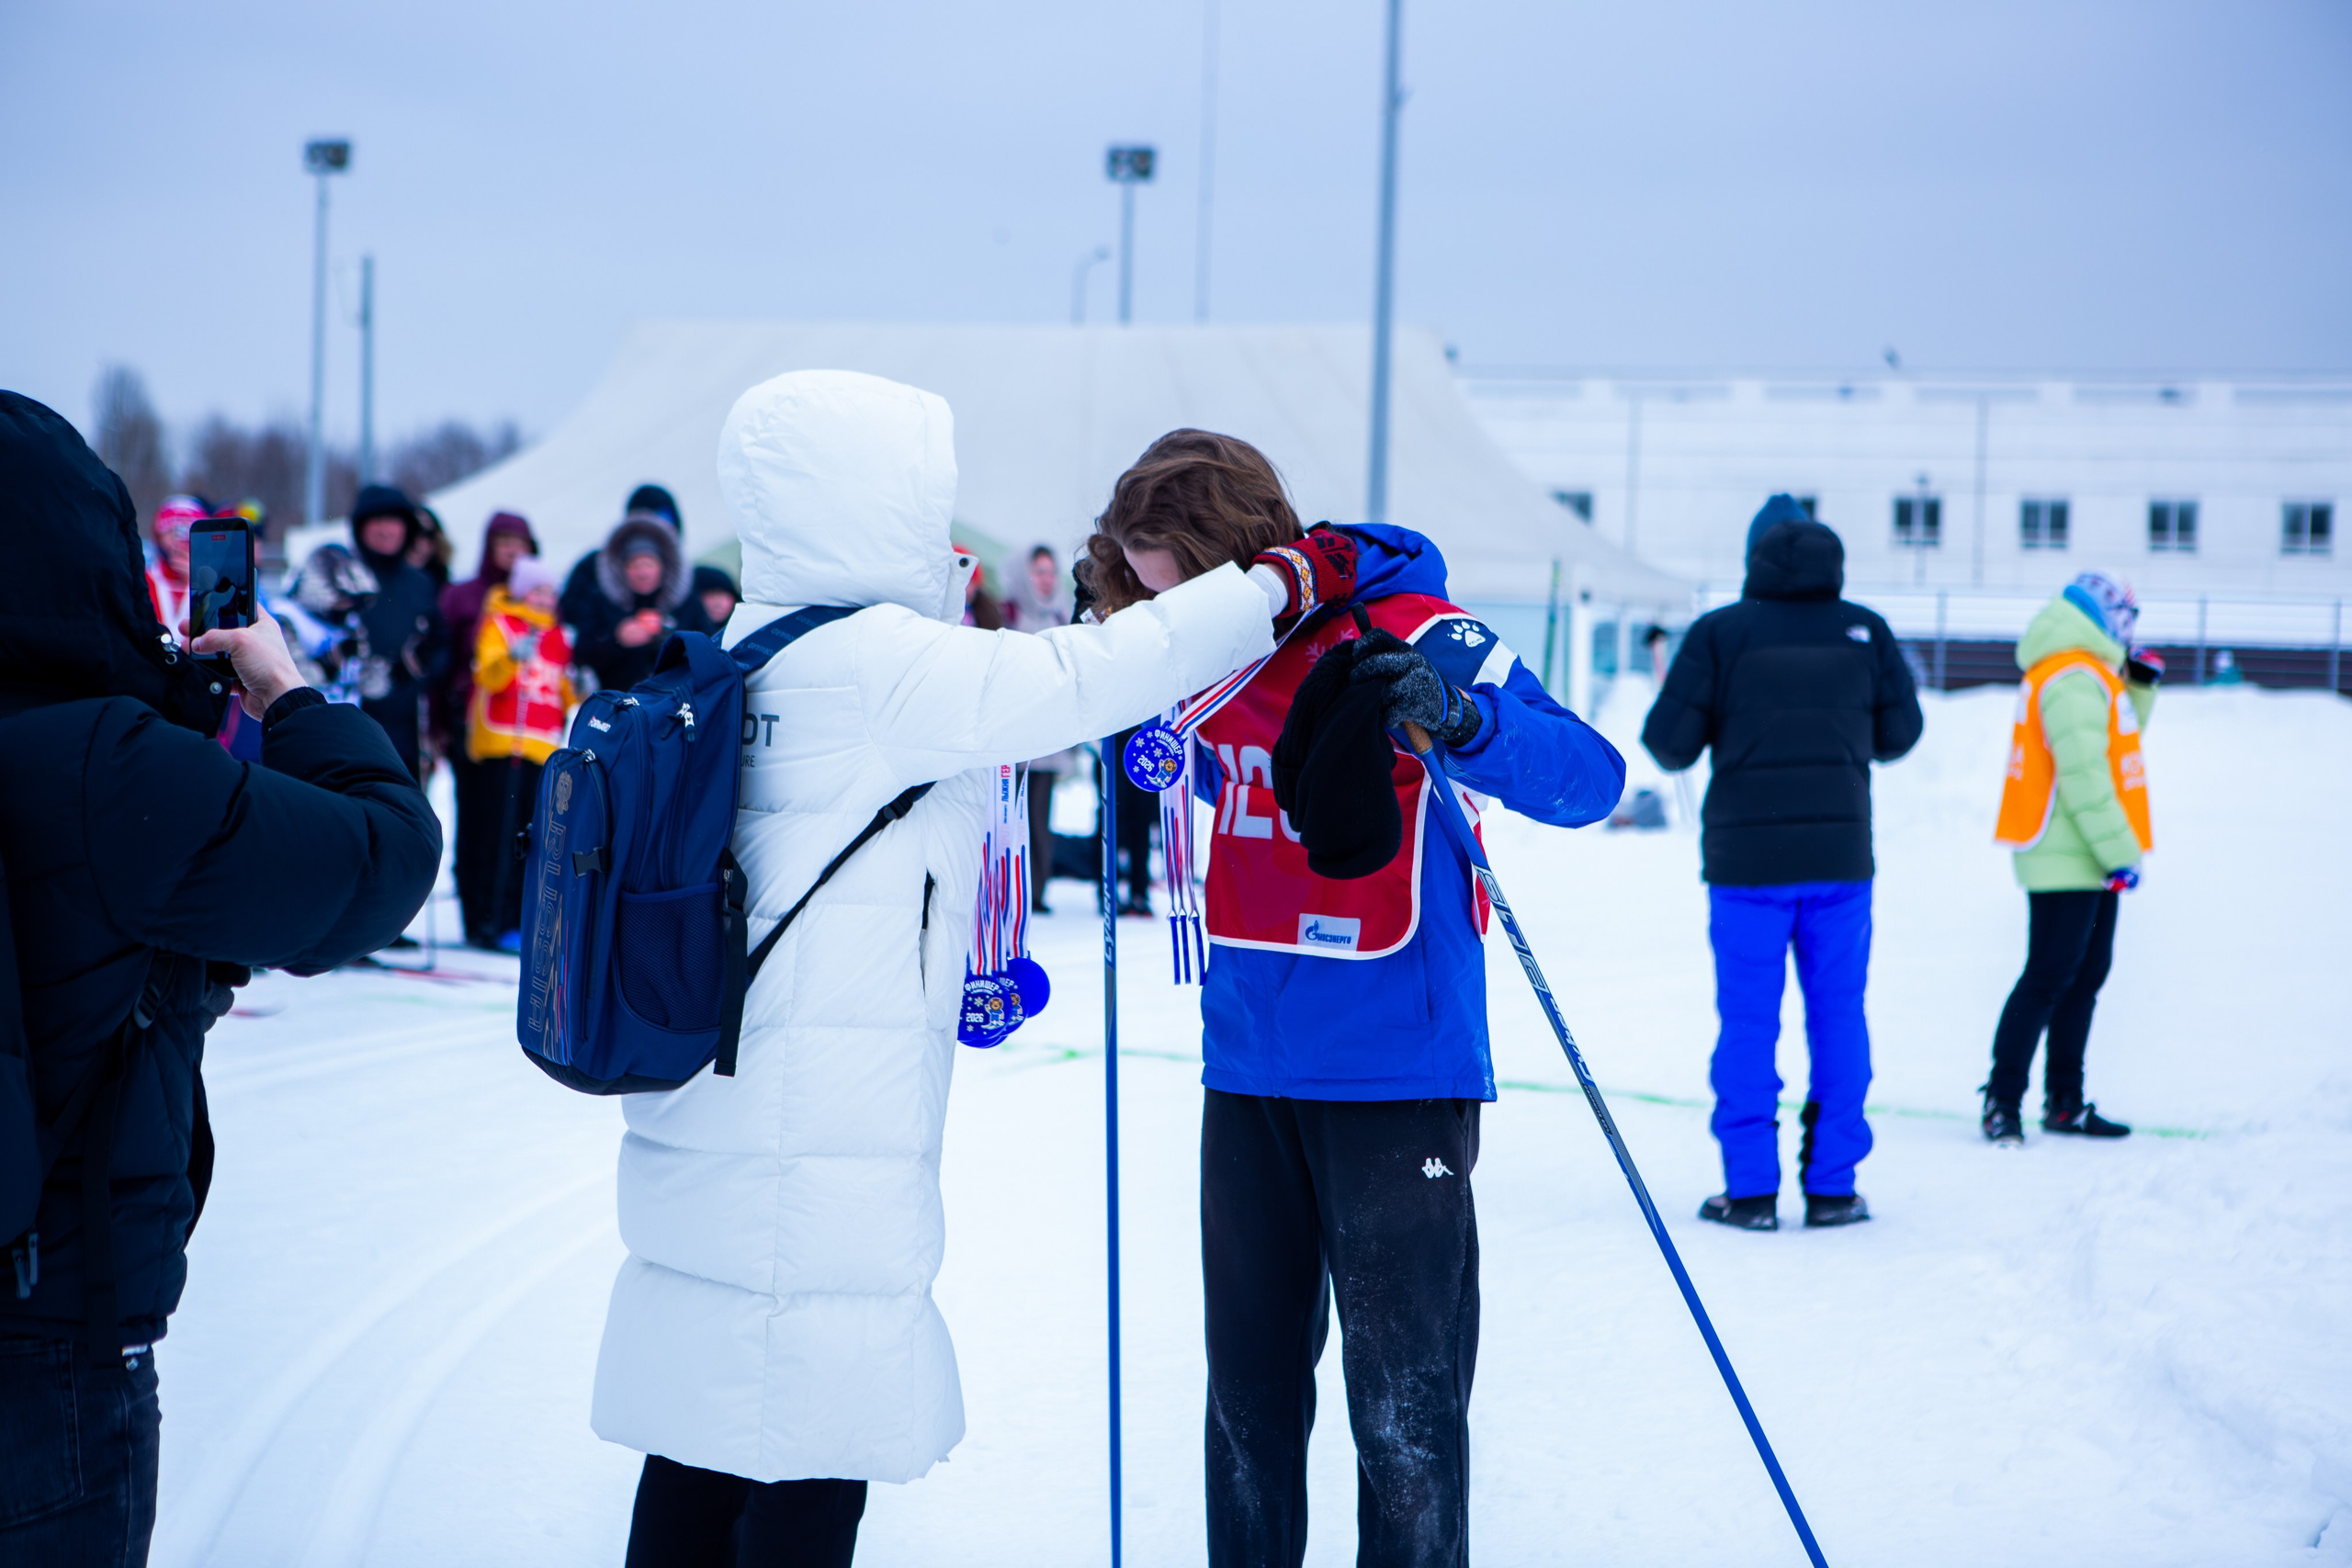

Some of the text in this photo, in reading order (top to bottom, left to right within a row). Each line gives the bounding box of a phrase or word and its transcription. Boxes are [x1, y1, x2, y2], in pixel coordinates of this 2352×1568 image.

[1154, 728, 1183, 755] ФИНИШЕР
[1136, 754, 1155, 773] 2026
[1317, 932, 1351, 944] МОСЭНЕРГО
[965, 979, 1000, 992] ФИНИШЕР
[966, 1012, 984, 1022] 2026
